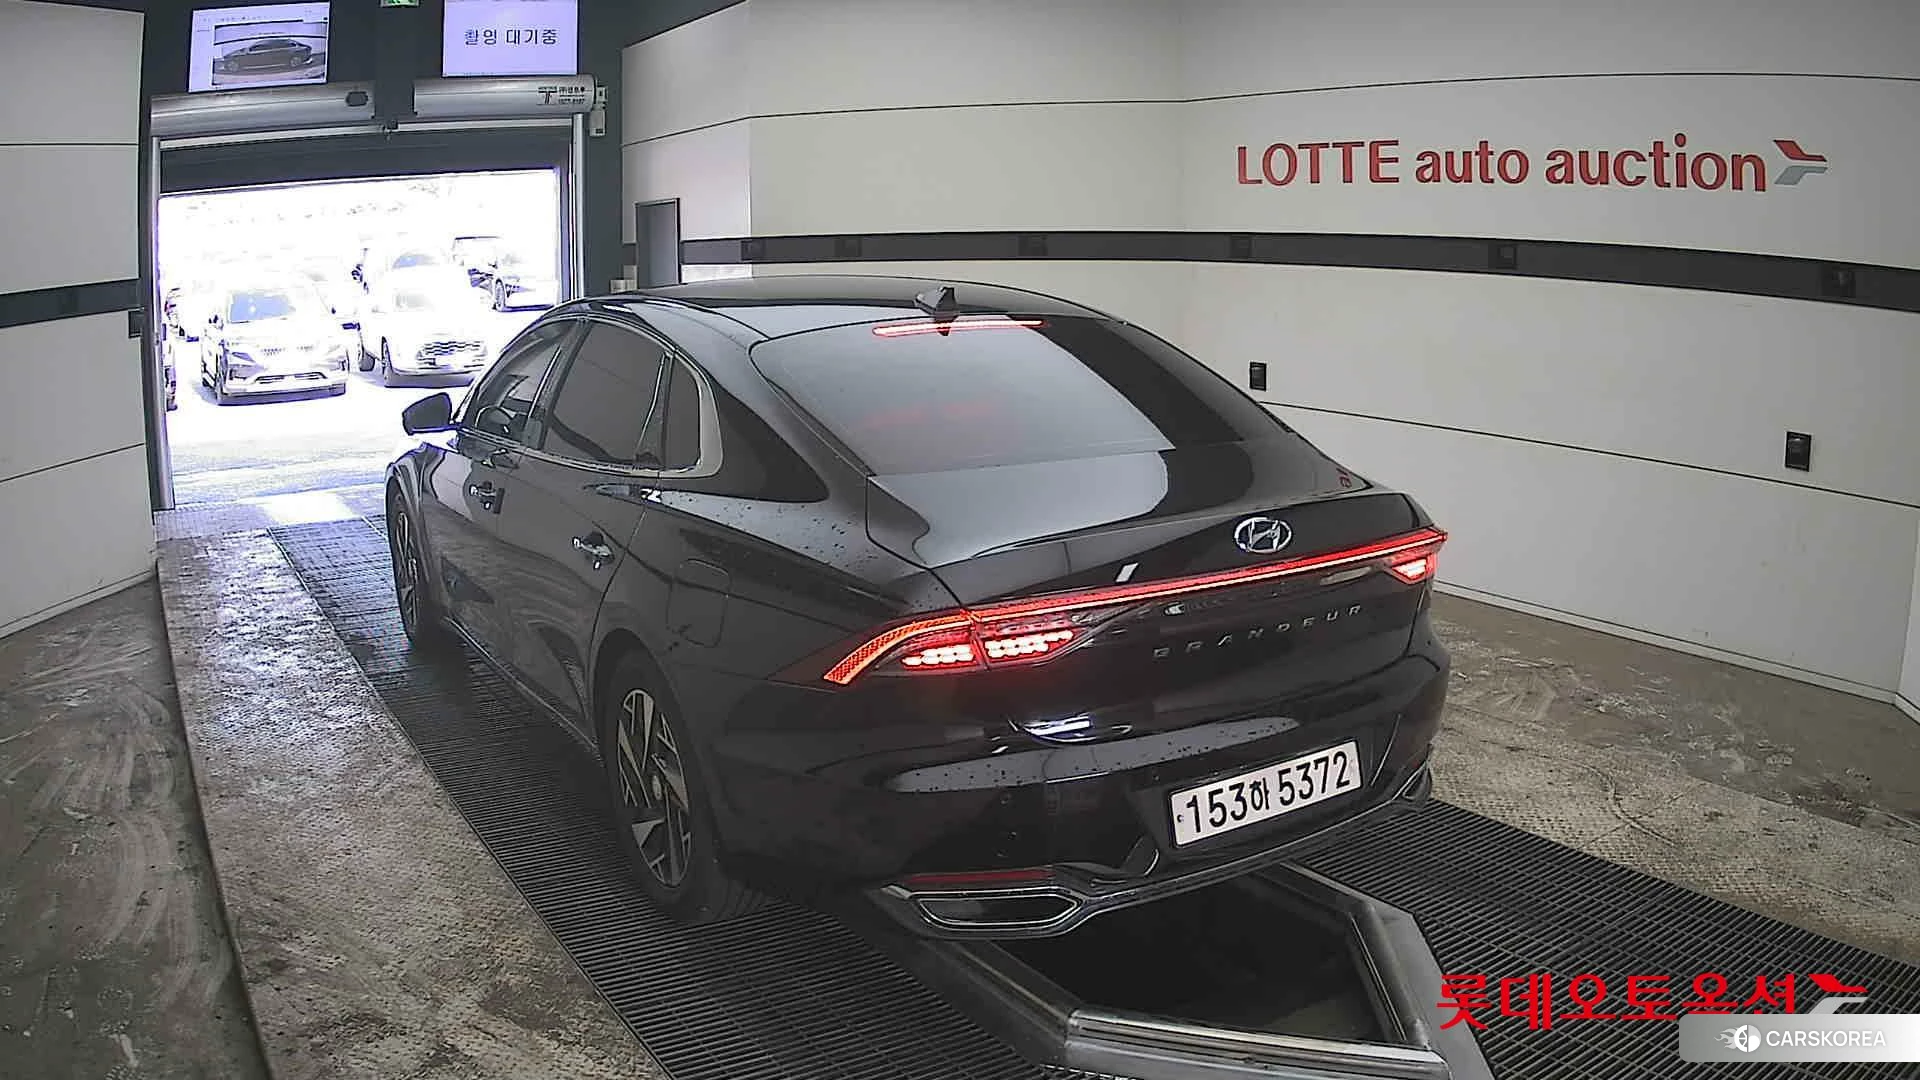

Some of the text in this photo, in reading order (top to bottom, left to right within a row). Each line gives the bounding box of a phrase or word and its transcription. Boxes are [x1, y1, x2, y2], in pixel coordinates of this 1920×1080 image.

[505, 29, 557, 46] 대기중
[1237, 133, 1767, 192] LOTTE auto auction
[1186, 751, 1351, 833] 153하 5372
